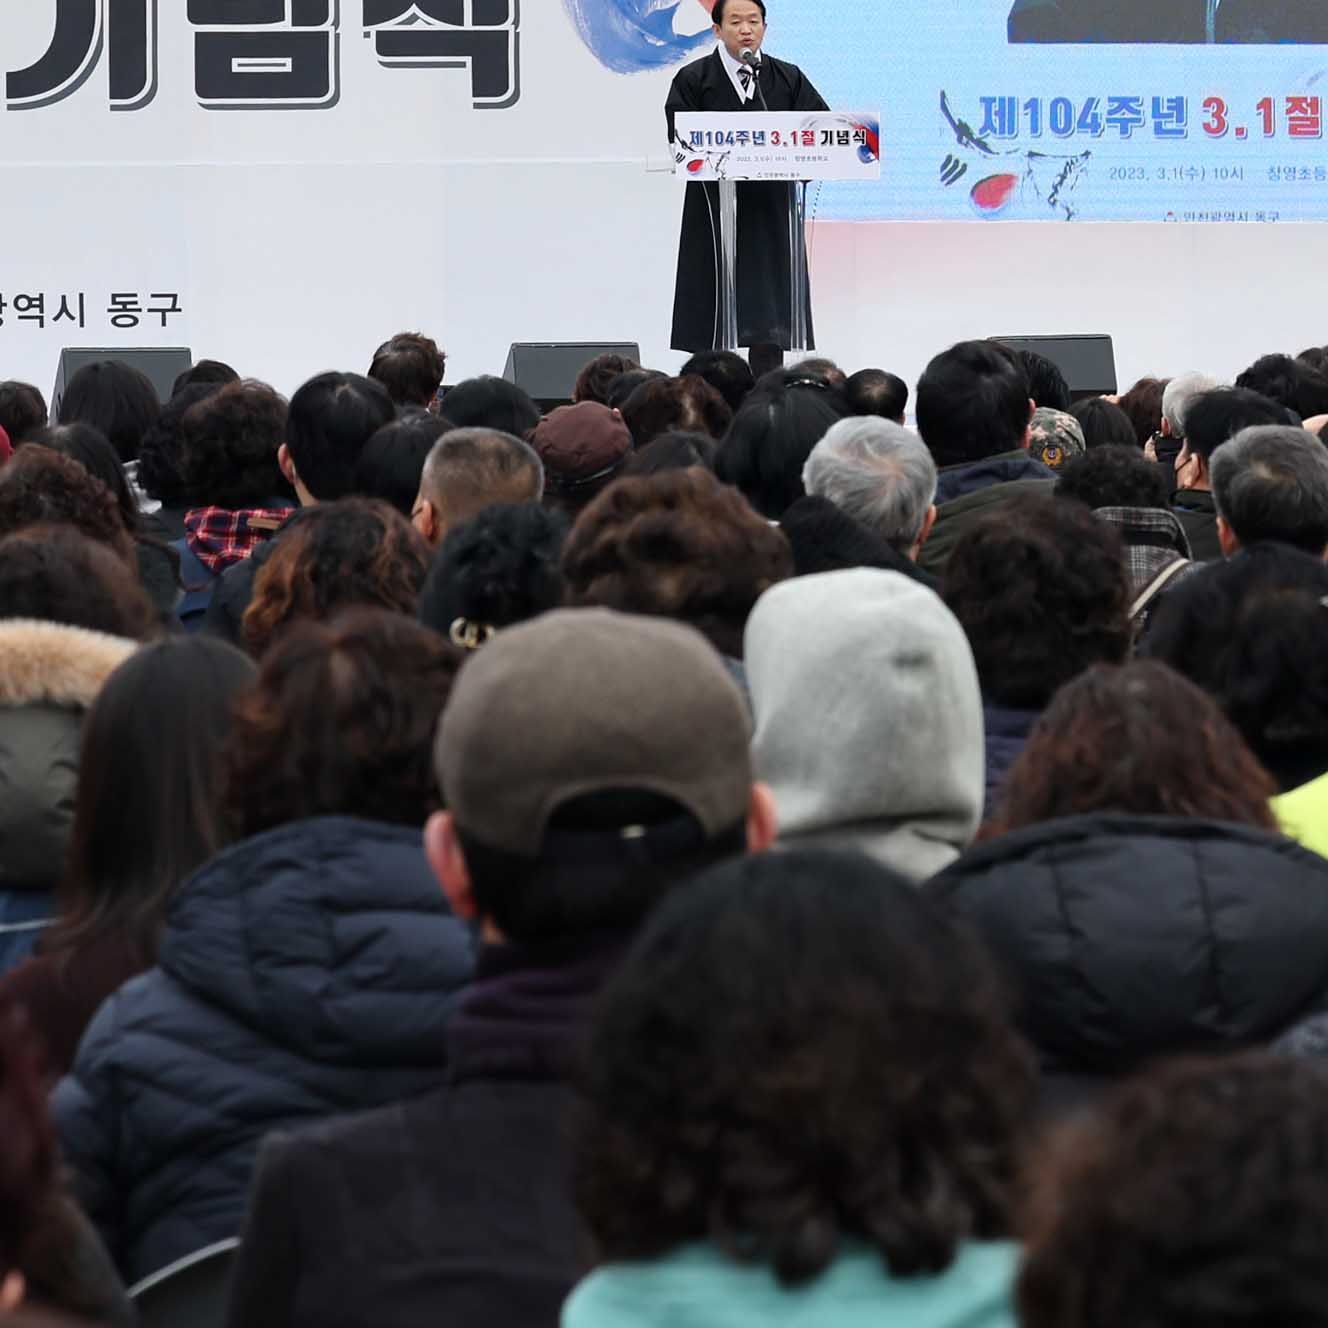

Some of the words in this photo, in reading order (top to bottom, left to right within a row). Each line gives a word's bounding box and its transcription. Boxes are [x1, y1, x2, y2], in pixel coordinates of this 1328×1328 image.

[978, 95, 1189, 139] 제104주년
[1202, 95, 1323, 139] 3.1절
[689, 130, 765, 146] 제104주년
[771, 130, 815, 146] 3.1절
[821, 129, 867, 145] 기념식
[1109, 167, 1150, 181] 2023.
[107, 292, 183, 328] 동구
